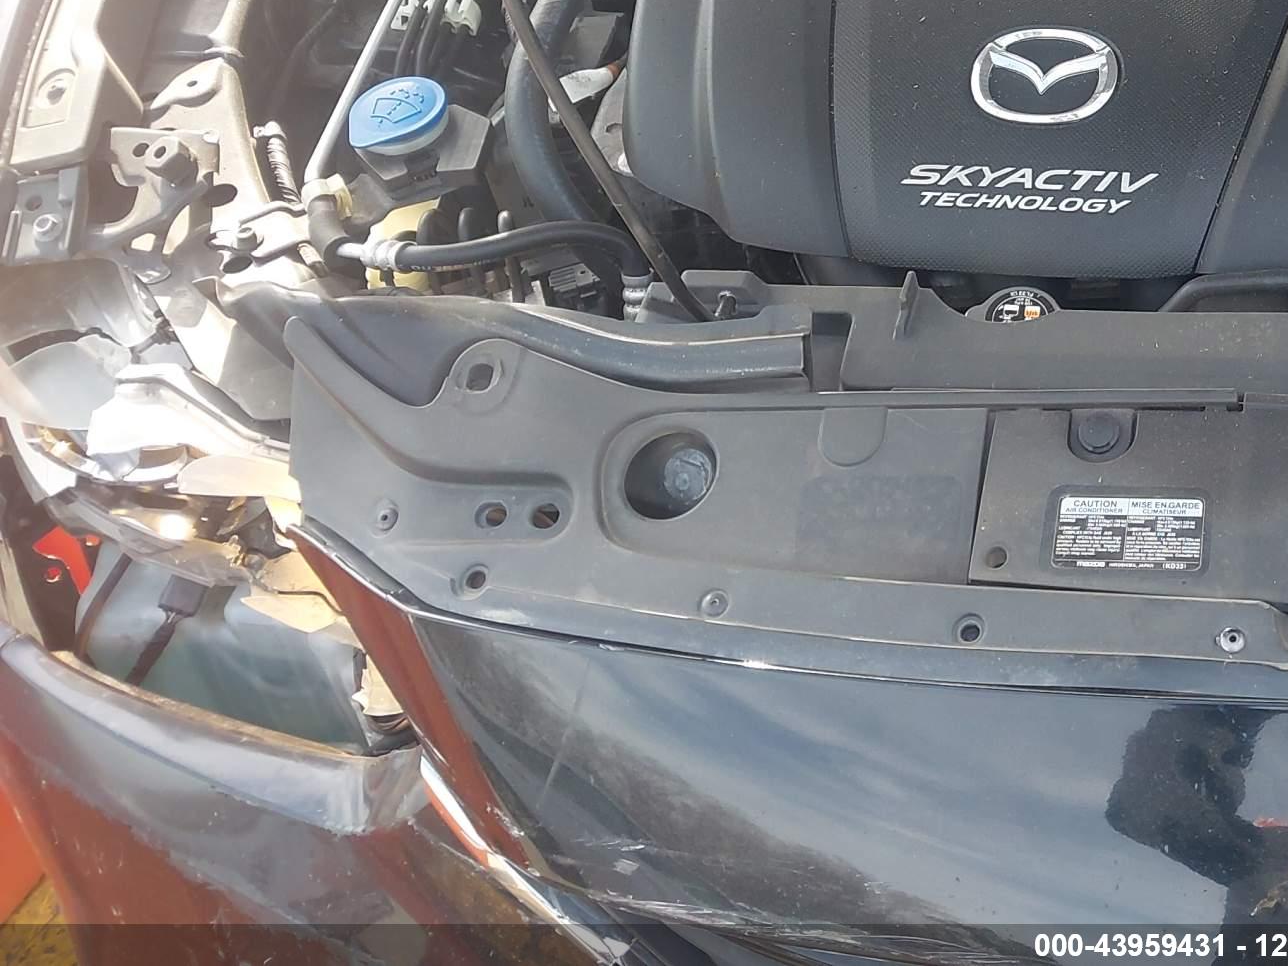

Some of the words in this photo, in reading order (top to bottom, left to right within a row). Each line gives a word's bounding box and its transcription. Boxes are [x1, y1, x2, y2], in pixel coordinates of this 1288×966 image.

[900, 164, 1159, 193] SKYACTIV
[920, 191, 1131, 213] TECHNOLOGY
[1073, 500, 1118, 508] CAUTION
[1131, 501, 1153, 509] MISE
[1154, 501, 1167, 509] EN
